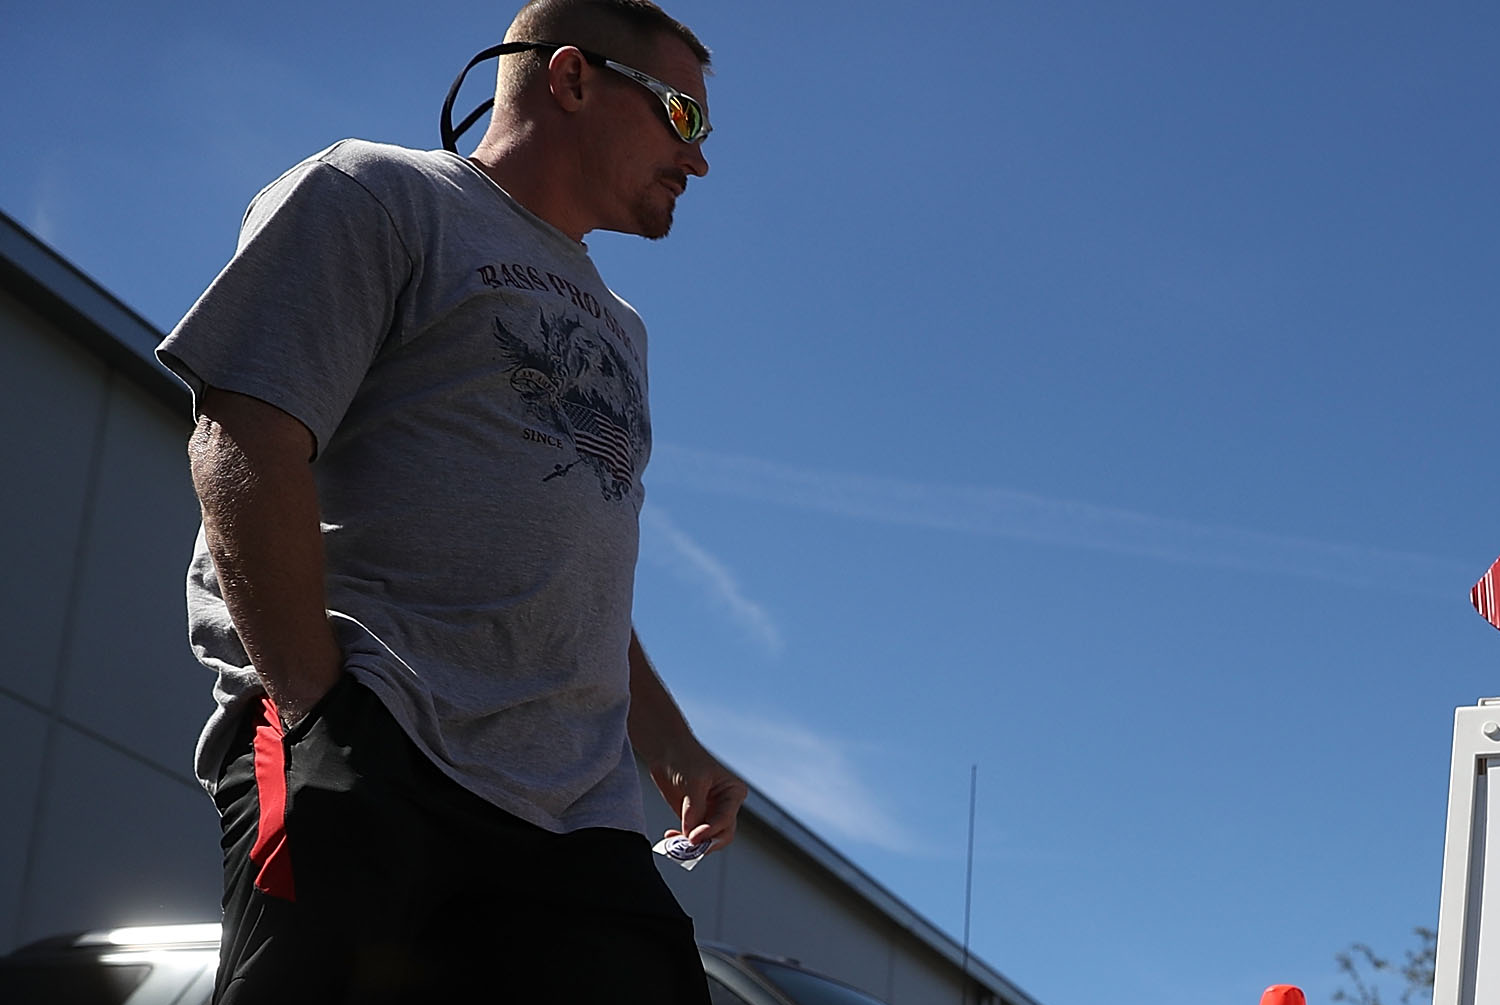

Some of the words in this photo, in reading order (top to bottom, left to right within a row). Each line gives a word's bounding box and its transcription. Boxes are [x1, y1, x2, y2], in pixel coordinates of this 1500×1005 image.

[476, 263, 549, 291] BASS
[545, 271, 600, 319] PRO
[522, 427, 564, 450] SINCE
